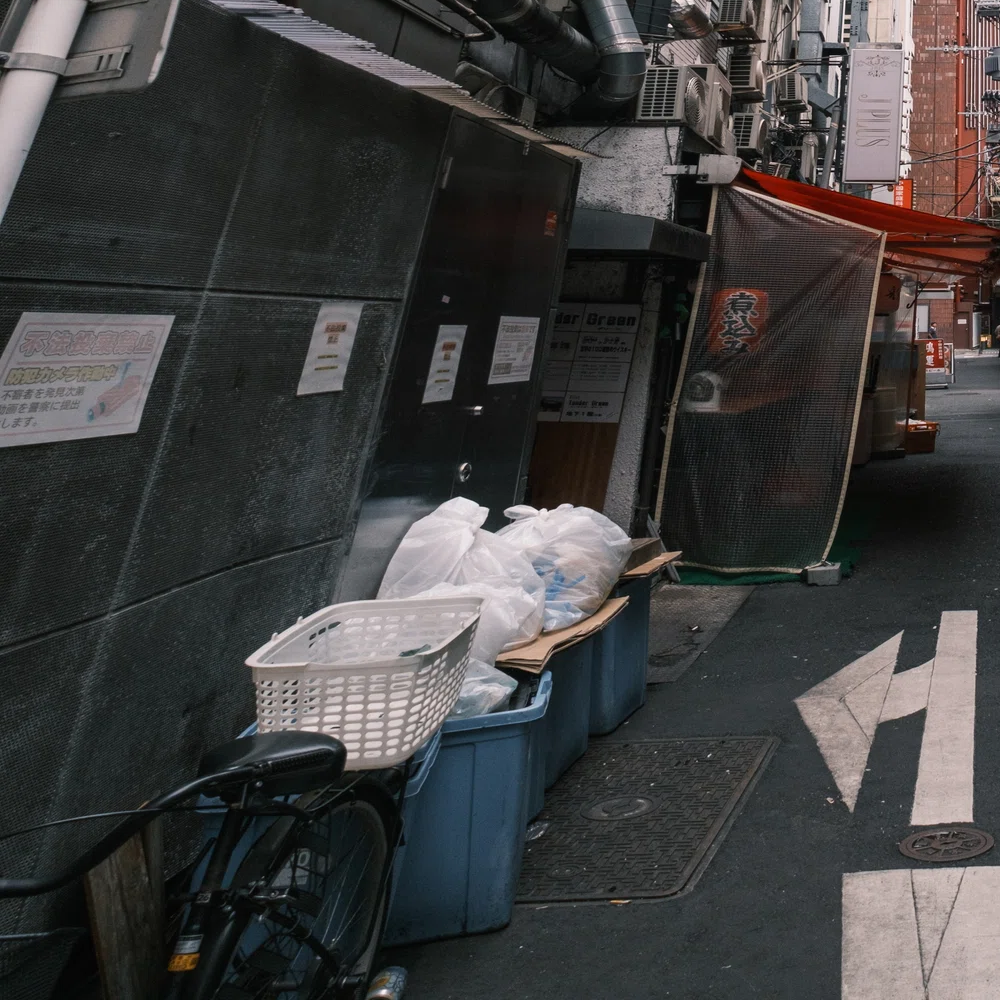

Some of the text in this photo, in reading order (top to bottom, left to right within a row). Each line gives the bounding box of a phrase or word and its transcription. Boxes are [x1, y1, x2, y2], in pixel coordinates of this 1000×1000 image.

[20, 330, 156, 357] 不法投棄禁止
[4, 365, 118, 386] 防犯カメラ作動中
[2, 387, 86, 400] 不審者を発見次第
